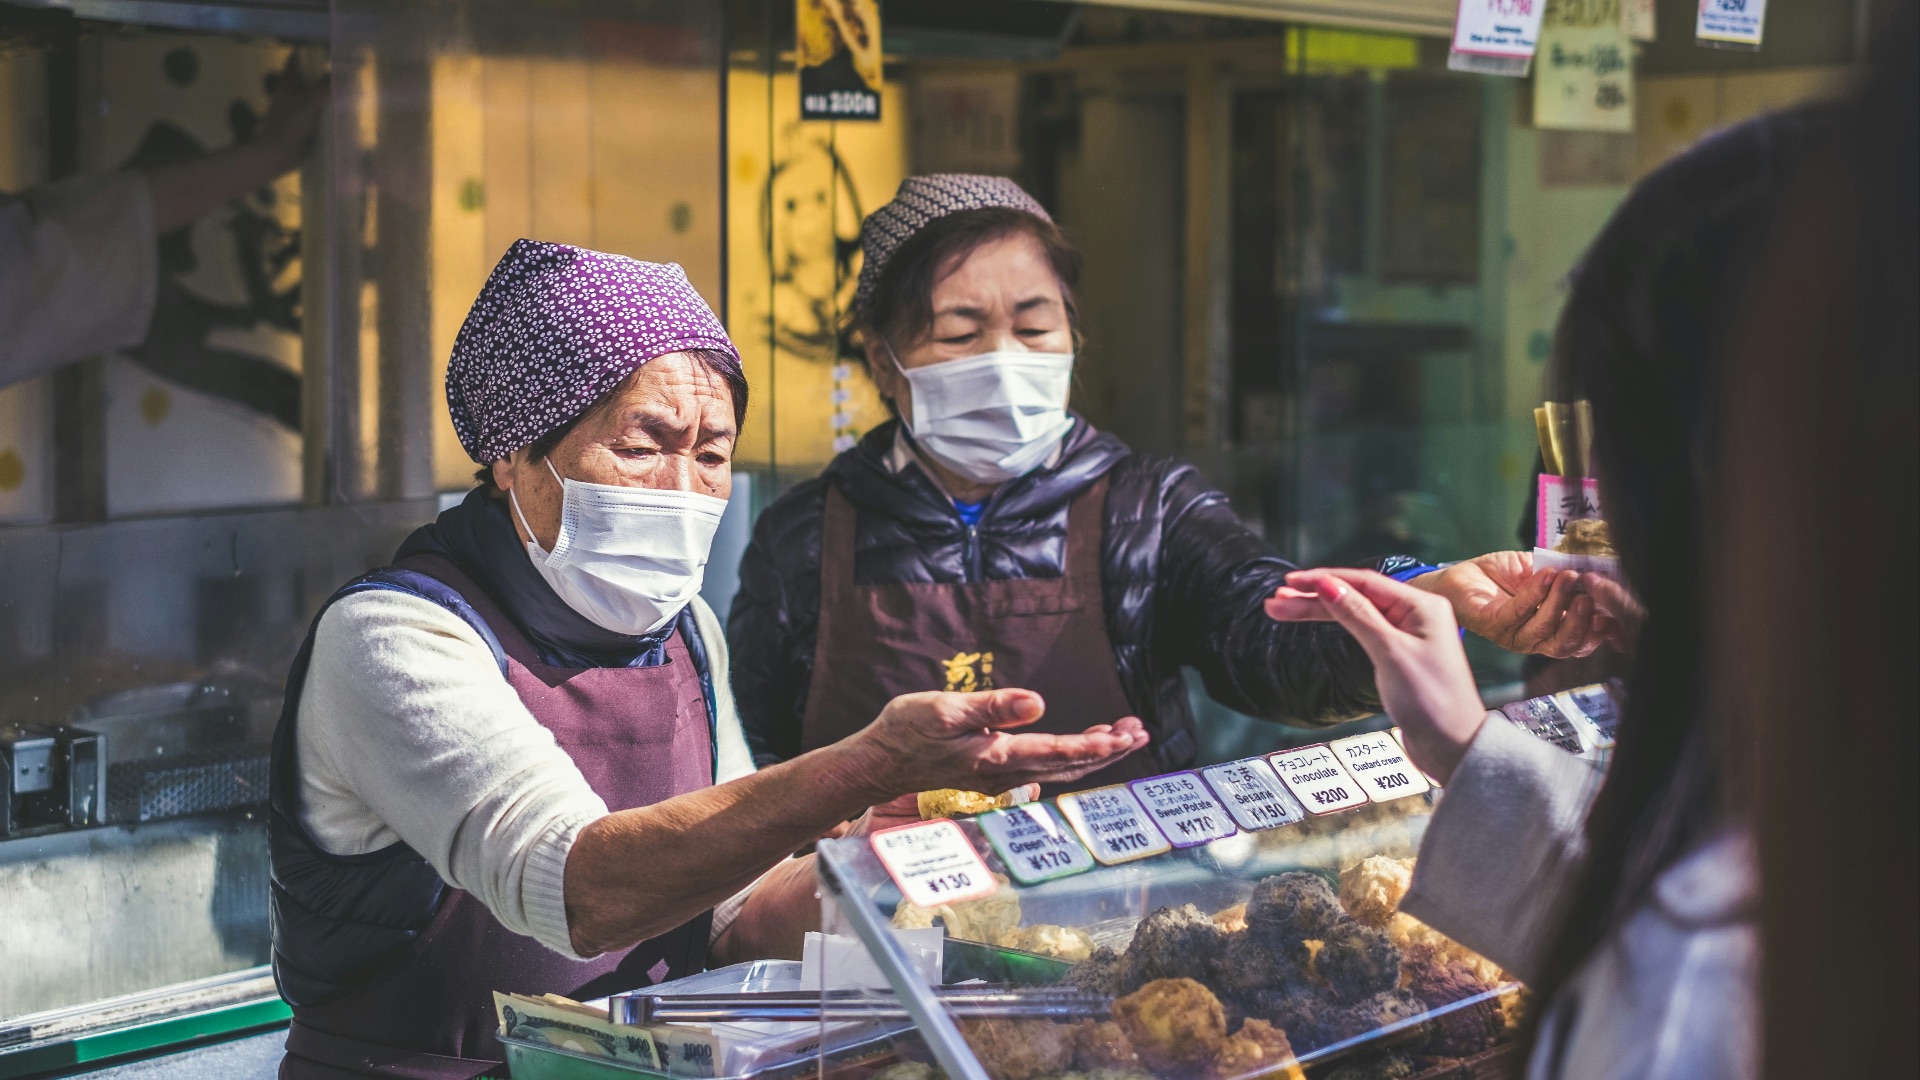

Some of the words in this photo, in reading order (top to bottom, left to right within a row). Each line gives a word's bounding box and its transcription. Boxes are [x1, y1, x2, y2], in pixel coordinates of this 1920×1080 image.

[1345, 740, 1387, 758] カスタード
[1278, 752, 1330, 771] チョコレート
[1352, 759, 1381, 771] Custard
[1381, 756, 1404, 767] cream
[1223, 766, 1255, 783] ごま
[1292, 767, 1338, 784] chocolate
[1374, 772, 1409, 789] ¥200
[1144, 778, 1194, 797] さつまいも
[1311, 787, 1348, 805] ¥200
[1155, 806, 1182, 818] Sweet
[1091, 817, 1138, 834] Pumpkn
[1175, 816, 1214, 835] ¥170
[1008, 839, 1046, 854] Green
[1106, 833, 1148, 852] ¥170
[1027, 850, 1071, 871] ¥170
[926, 872, 971, 893] ¥130
[683, 1042, 712, 1061] 1000
